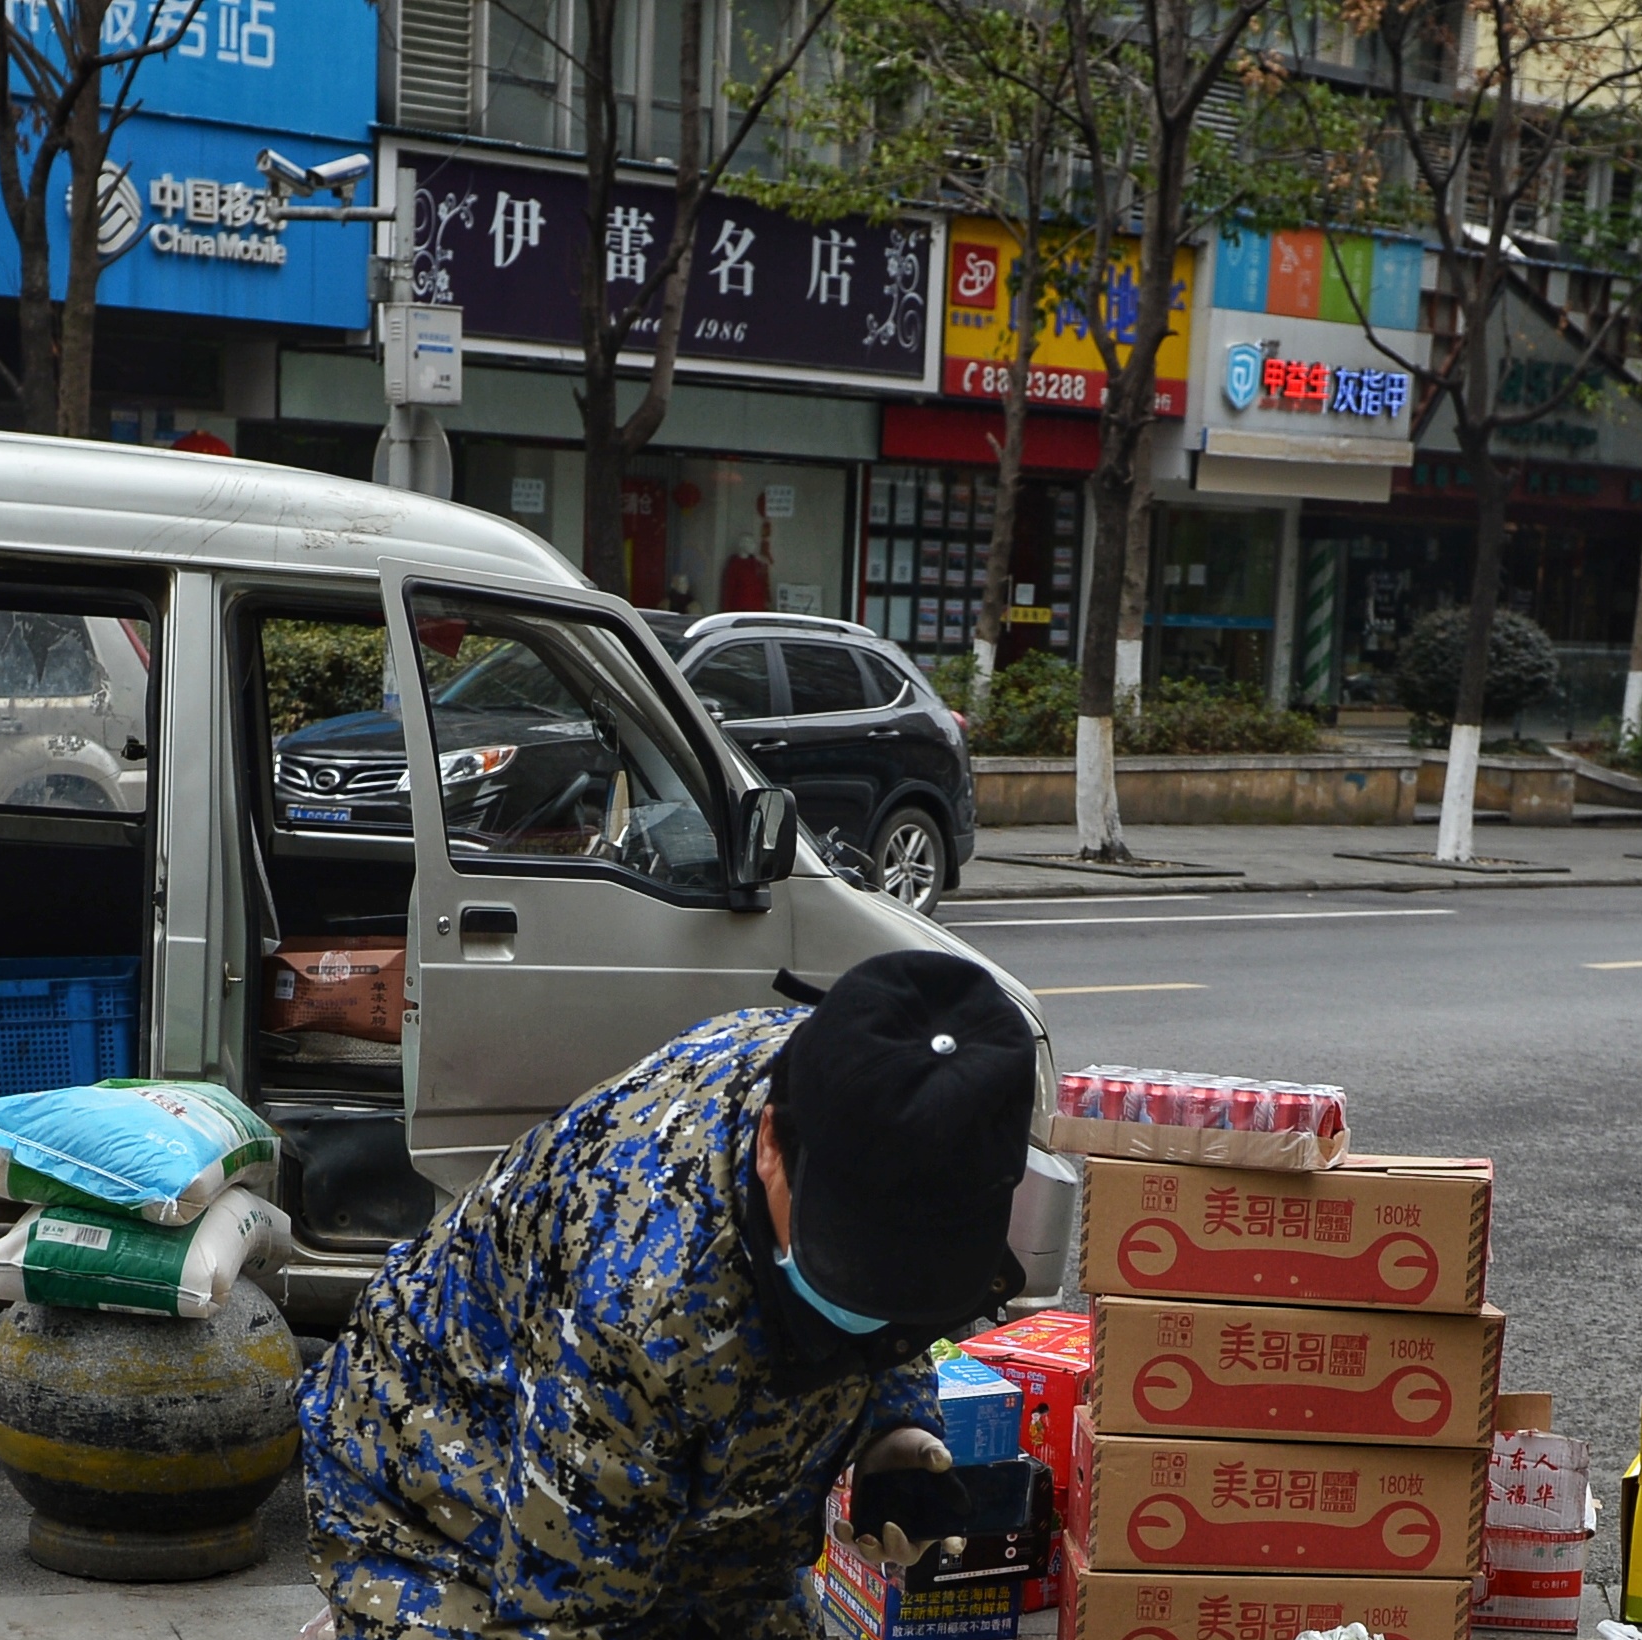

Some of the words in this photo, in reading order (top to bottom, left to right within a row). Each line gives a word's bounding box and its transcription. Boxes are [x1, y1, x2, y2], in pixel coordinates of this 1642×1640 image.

[151, 222, 216, 258] China
[216, 228, 287, 266] Mobile
[488, 191, 857, 306] 伊蕾名店
[695, 317, 748, 343] 1986
[982, 366, 1086, 401] 8823288
[1333, 366, 1410, 418] 灰指甲
[1203, 1186, 1312, 1240] 美哥哥
[1374, 1203, 1422, 1228] 180枚
[1219, 1322, 1327, 1376] 美哥哥
[1388, 1337, 1435, 1362] 180枚
[1212, 1460, 1318, 1512] 美哥哥
[1377, 1473, 1425, 1498] 180枚
[1362, 1605, 1409, 1631] 180枚
